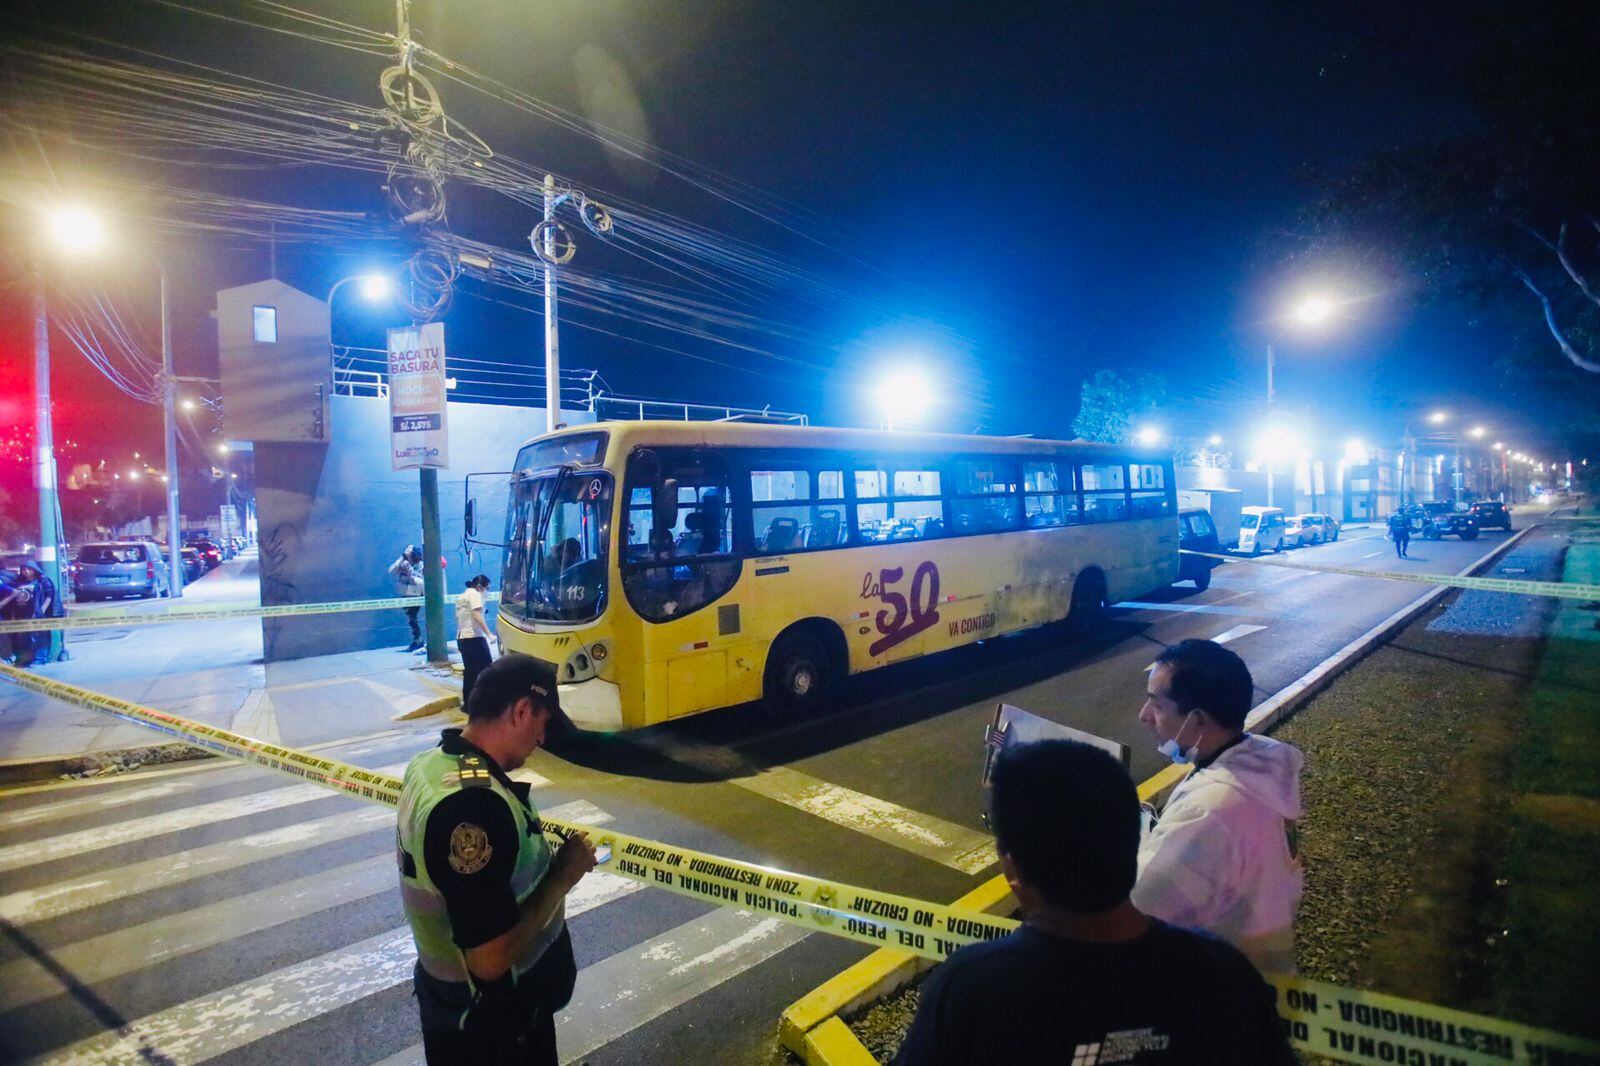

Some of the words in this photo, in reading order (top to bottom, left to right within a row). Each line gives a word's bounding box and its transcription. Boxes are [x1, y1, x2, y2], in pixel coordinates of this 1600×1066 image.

[390, 350, 420, 362] SACA
[424, 347, 439, 359] TU
[391, 360, 440, 374] BASURA
[566, 585, 585, 600] 113
[860, 572, 881, 599] la
[876, 561, 940, 636] 50
[948, 620, 959, 637] VA
[961, 613, 996, 634] CONTIGO
[375, 790, 399, 806] CIONAL
[666, 853, 682, 868] NO
[653, 867, 672, 885] DEL
[689, 858, 763, 885] RESTRINGIDA
[678, 873, 738, 902] NACIONAL
[913, 909, 935, 928] NO
[895, 928, 925, 950] DEL
[1286, 989, 1318, 1015] NO
[1338, 999, 1515, 1060] RESTRINGIDA
